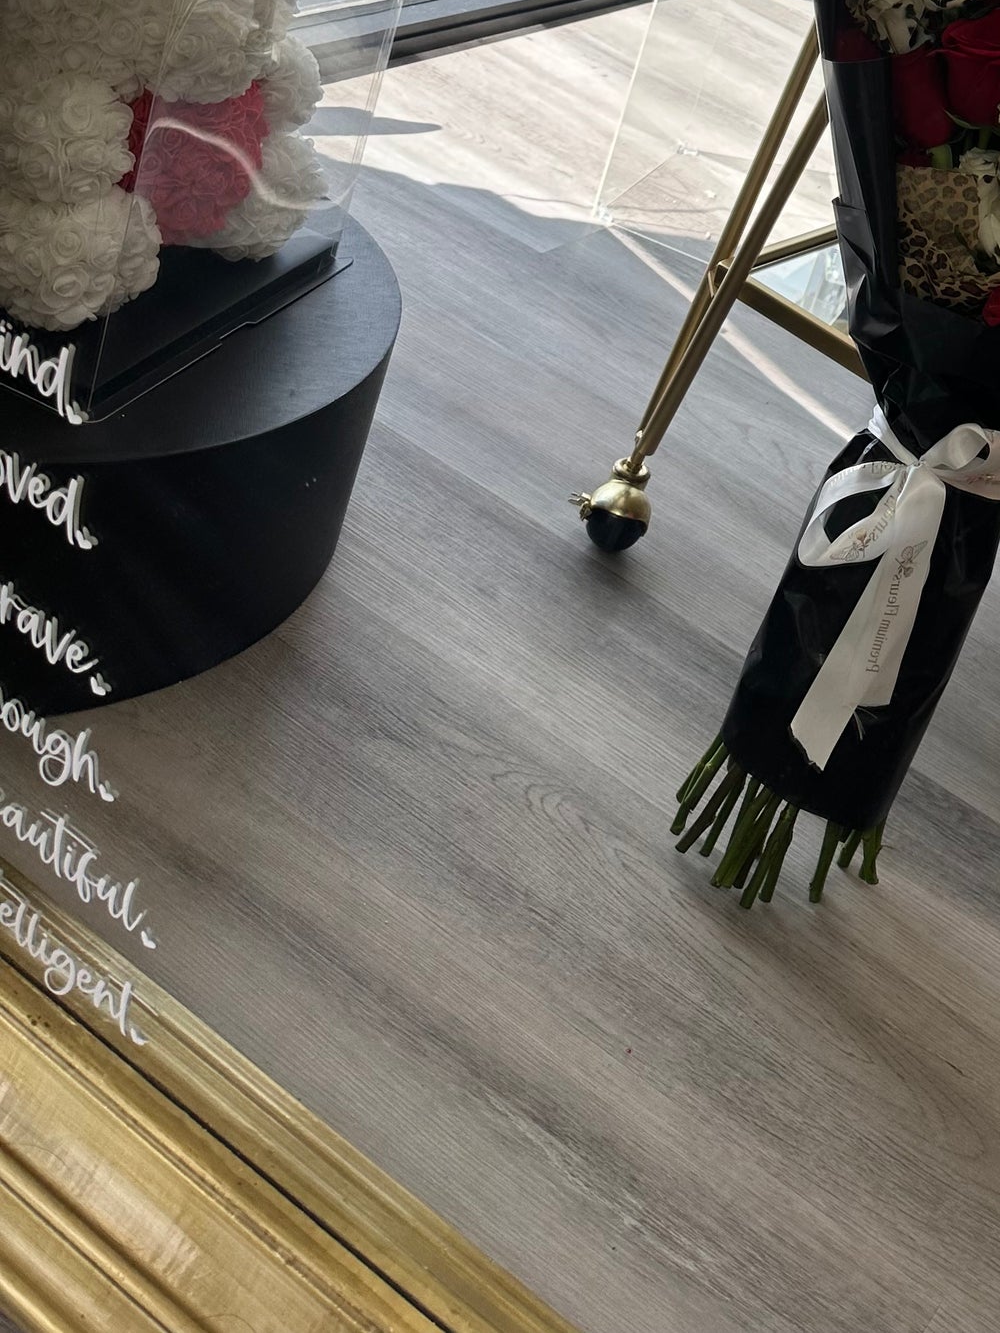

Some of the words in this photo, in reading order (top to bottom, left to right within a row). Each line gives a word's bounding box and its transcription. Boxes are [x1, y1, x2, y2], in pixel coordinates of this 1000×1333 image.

[0, 322, 69, 417] ind
[0, 583, 94, 673] rave
[0, 700, 96, 793] ough
[0, 804, 143, 932] autiful
[0, 896, 157, 1036] elligent
